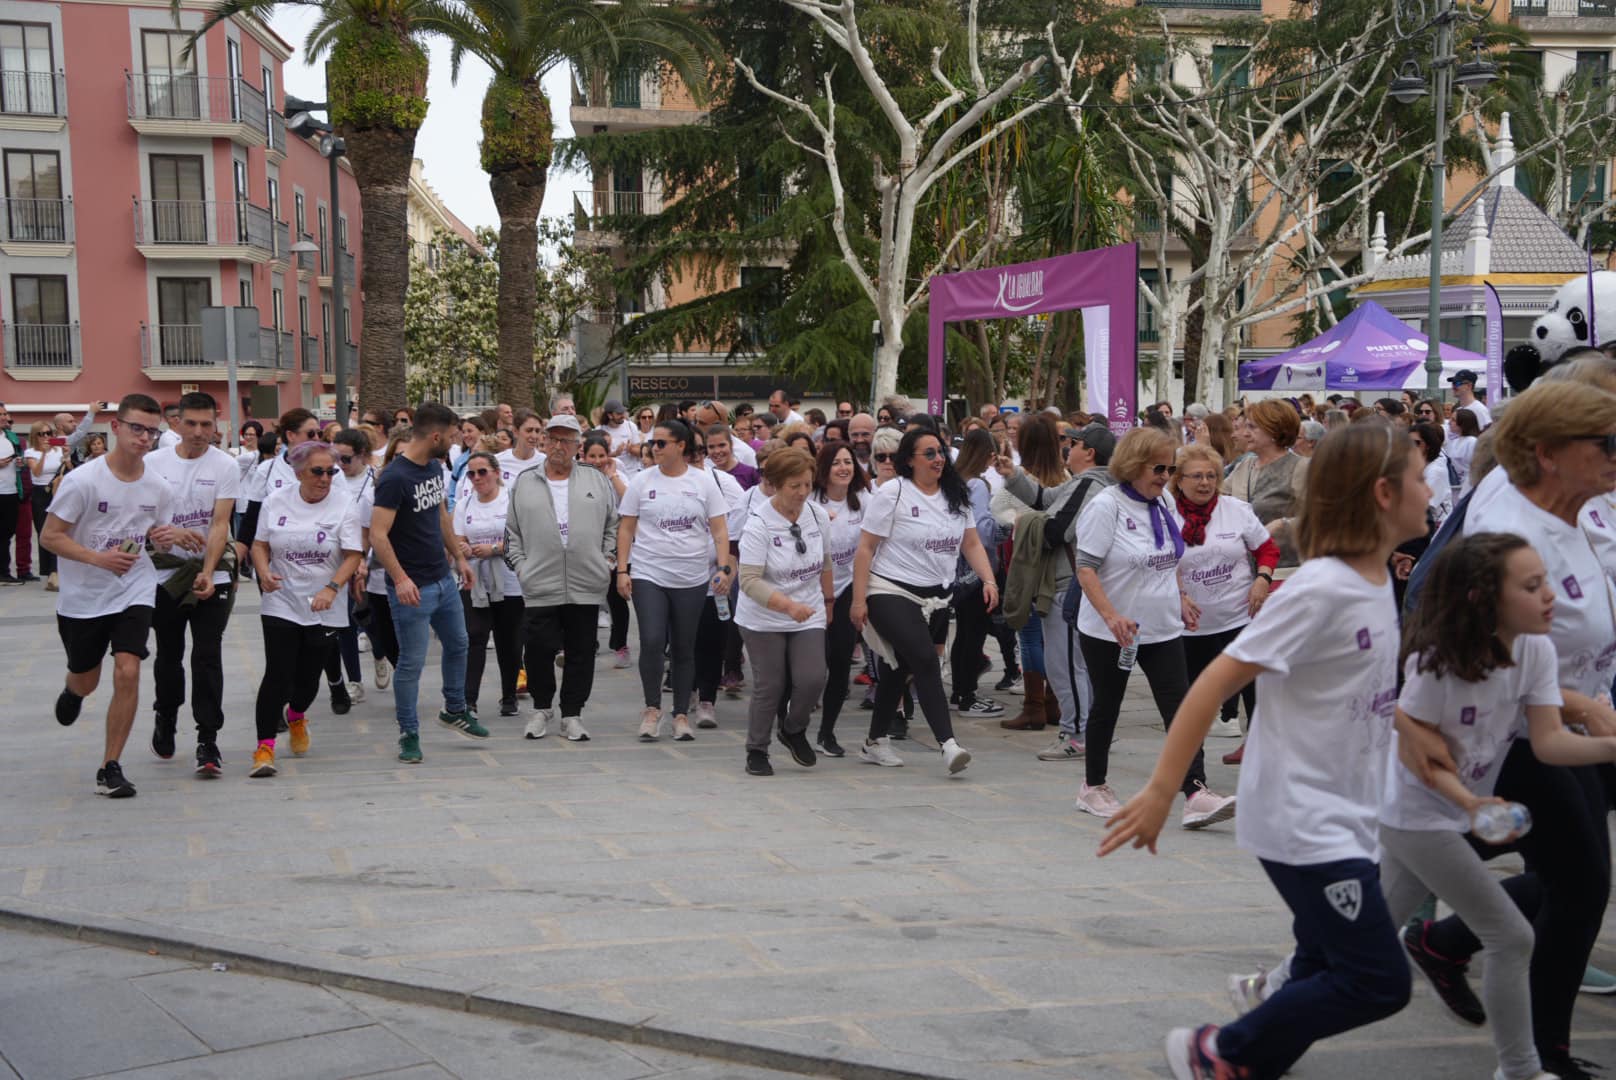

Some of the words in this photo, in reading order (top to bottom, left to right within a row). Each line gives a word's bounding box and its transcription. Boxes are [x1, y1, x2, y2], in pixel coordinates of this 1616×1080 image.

[1008, 274, 1016, 300] LA
[1016, 270, 1044, 299] IGUALDAD
[1365, 344, 1409, 352] PUNTO
[630, 377, 689, 390] RESECO
[286, 549, 332, 562] igualdad
